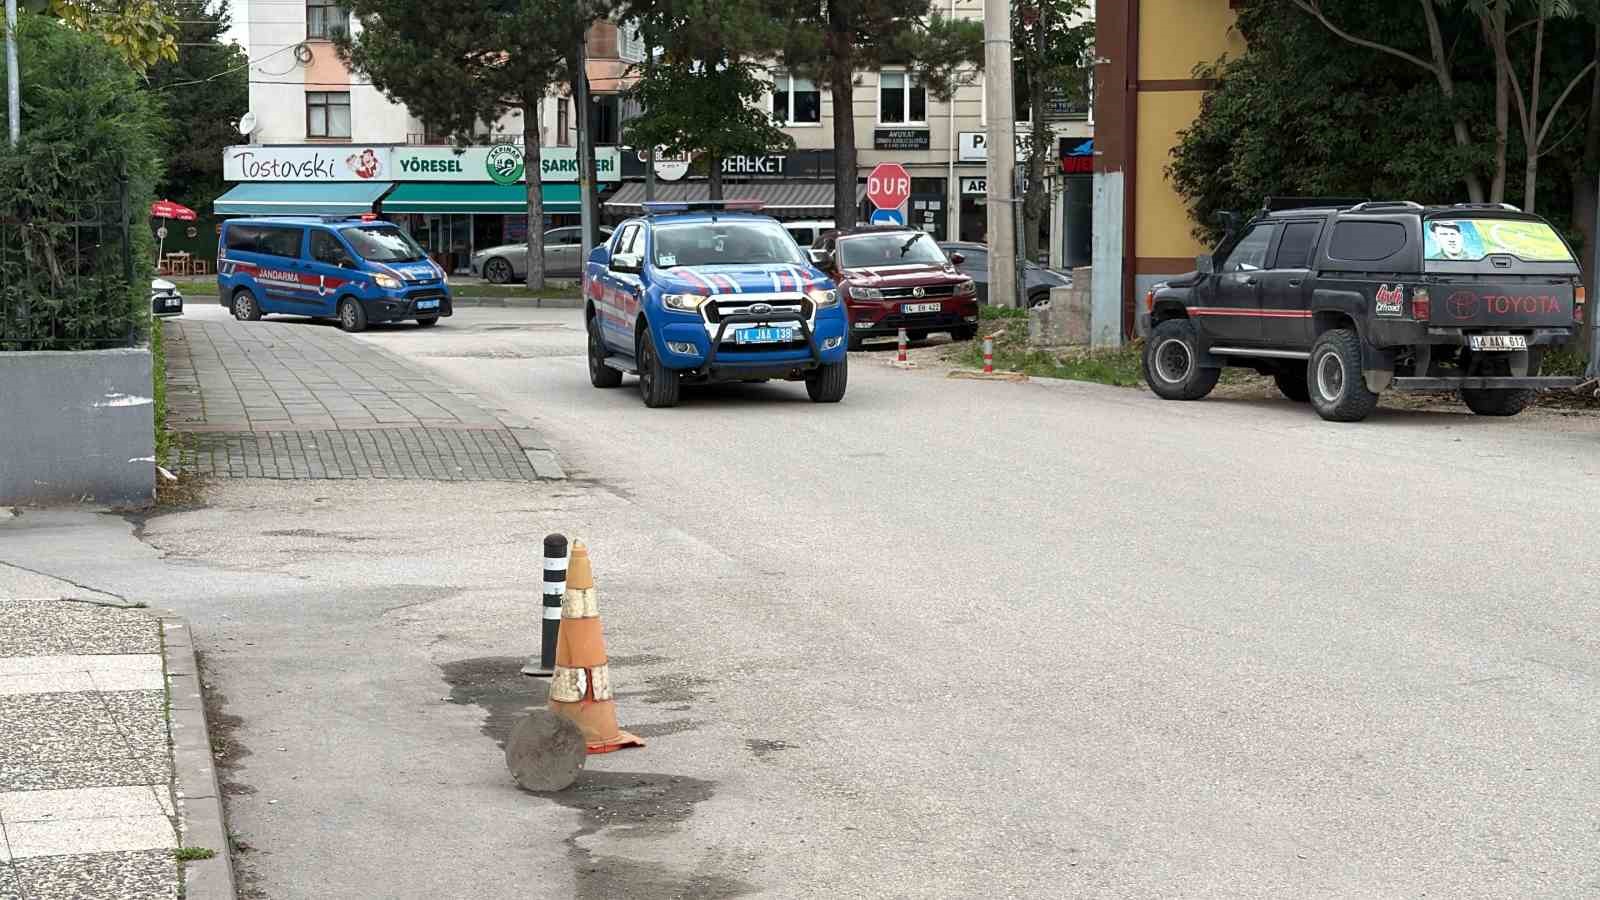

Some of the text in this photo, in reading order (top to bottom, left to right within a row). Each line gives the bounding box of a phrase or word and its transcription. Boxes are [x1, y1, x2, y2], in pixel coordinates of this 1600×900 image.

[233, 152, 334, 178] Tostovski
[400, 157, 463, 172] YÖRESEL
[542, 156, 614, 174] ŞARKERİ
[870, 177, 908, 195] DUR
[259, 269, 299, 282] JANDARMA
[1486, 295, 1561, 313] TOYOTA
